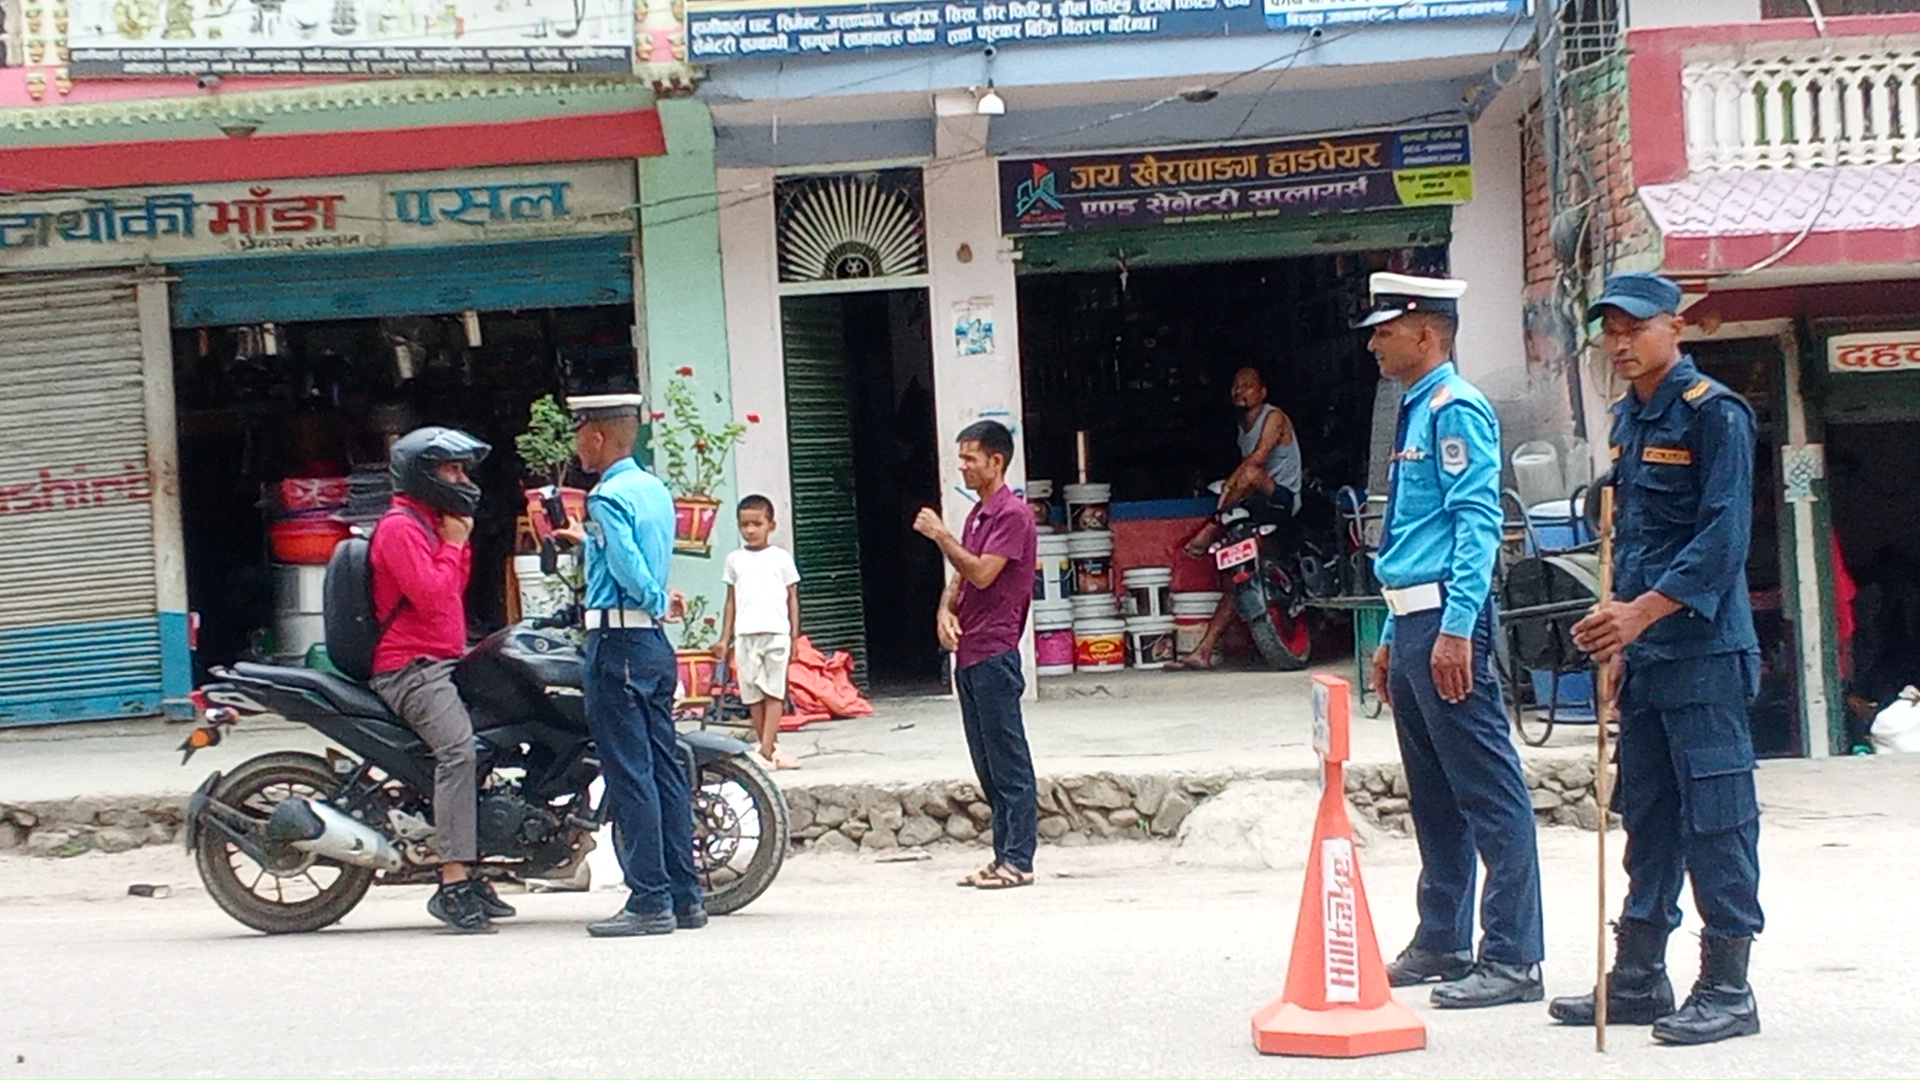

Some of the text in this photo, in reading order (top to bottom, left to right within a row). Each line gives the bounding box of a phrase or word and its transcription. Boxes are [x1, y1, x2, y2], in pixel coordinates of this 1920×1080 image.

[1070, 164, 1121, 189] जय
[206, 186, 345, 236] भाँडा
[388, 180, 571, 226] पसल
[1328, 857, 1356, 989] Hilltake
